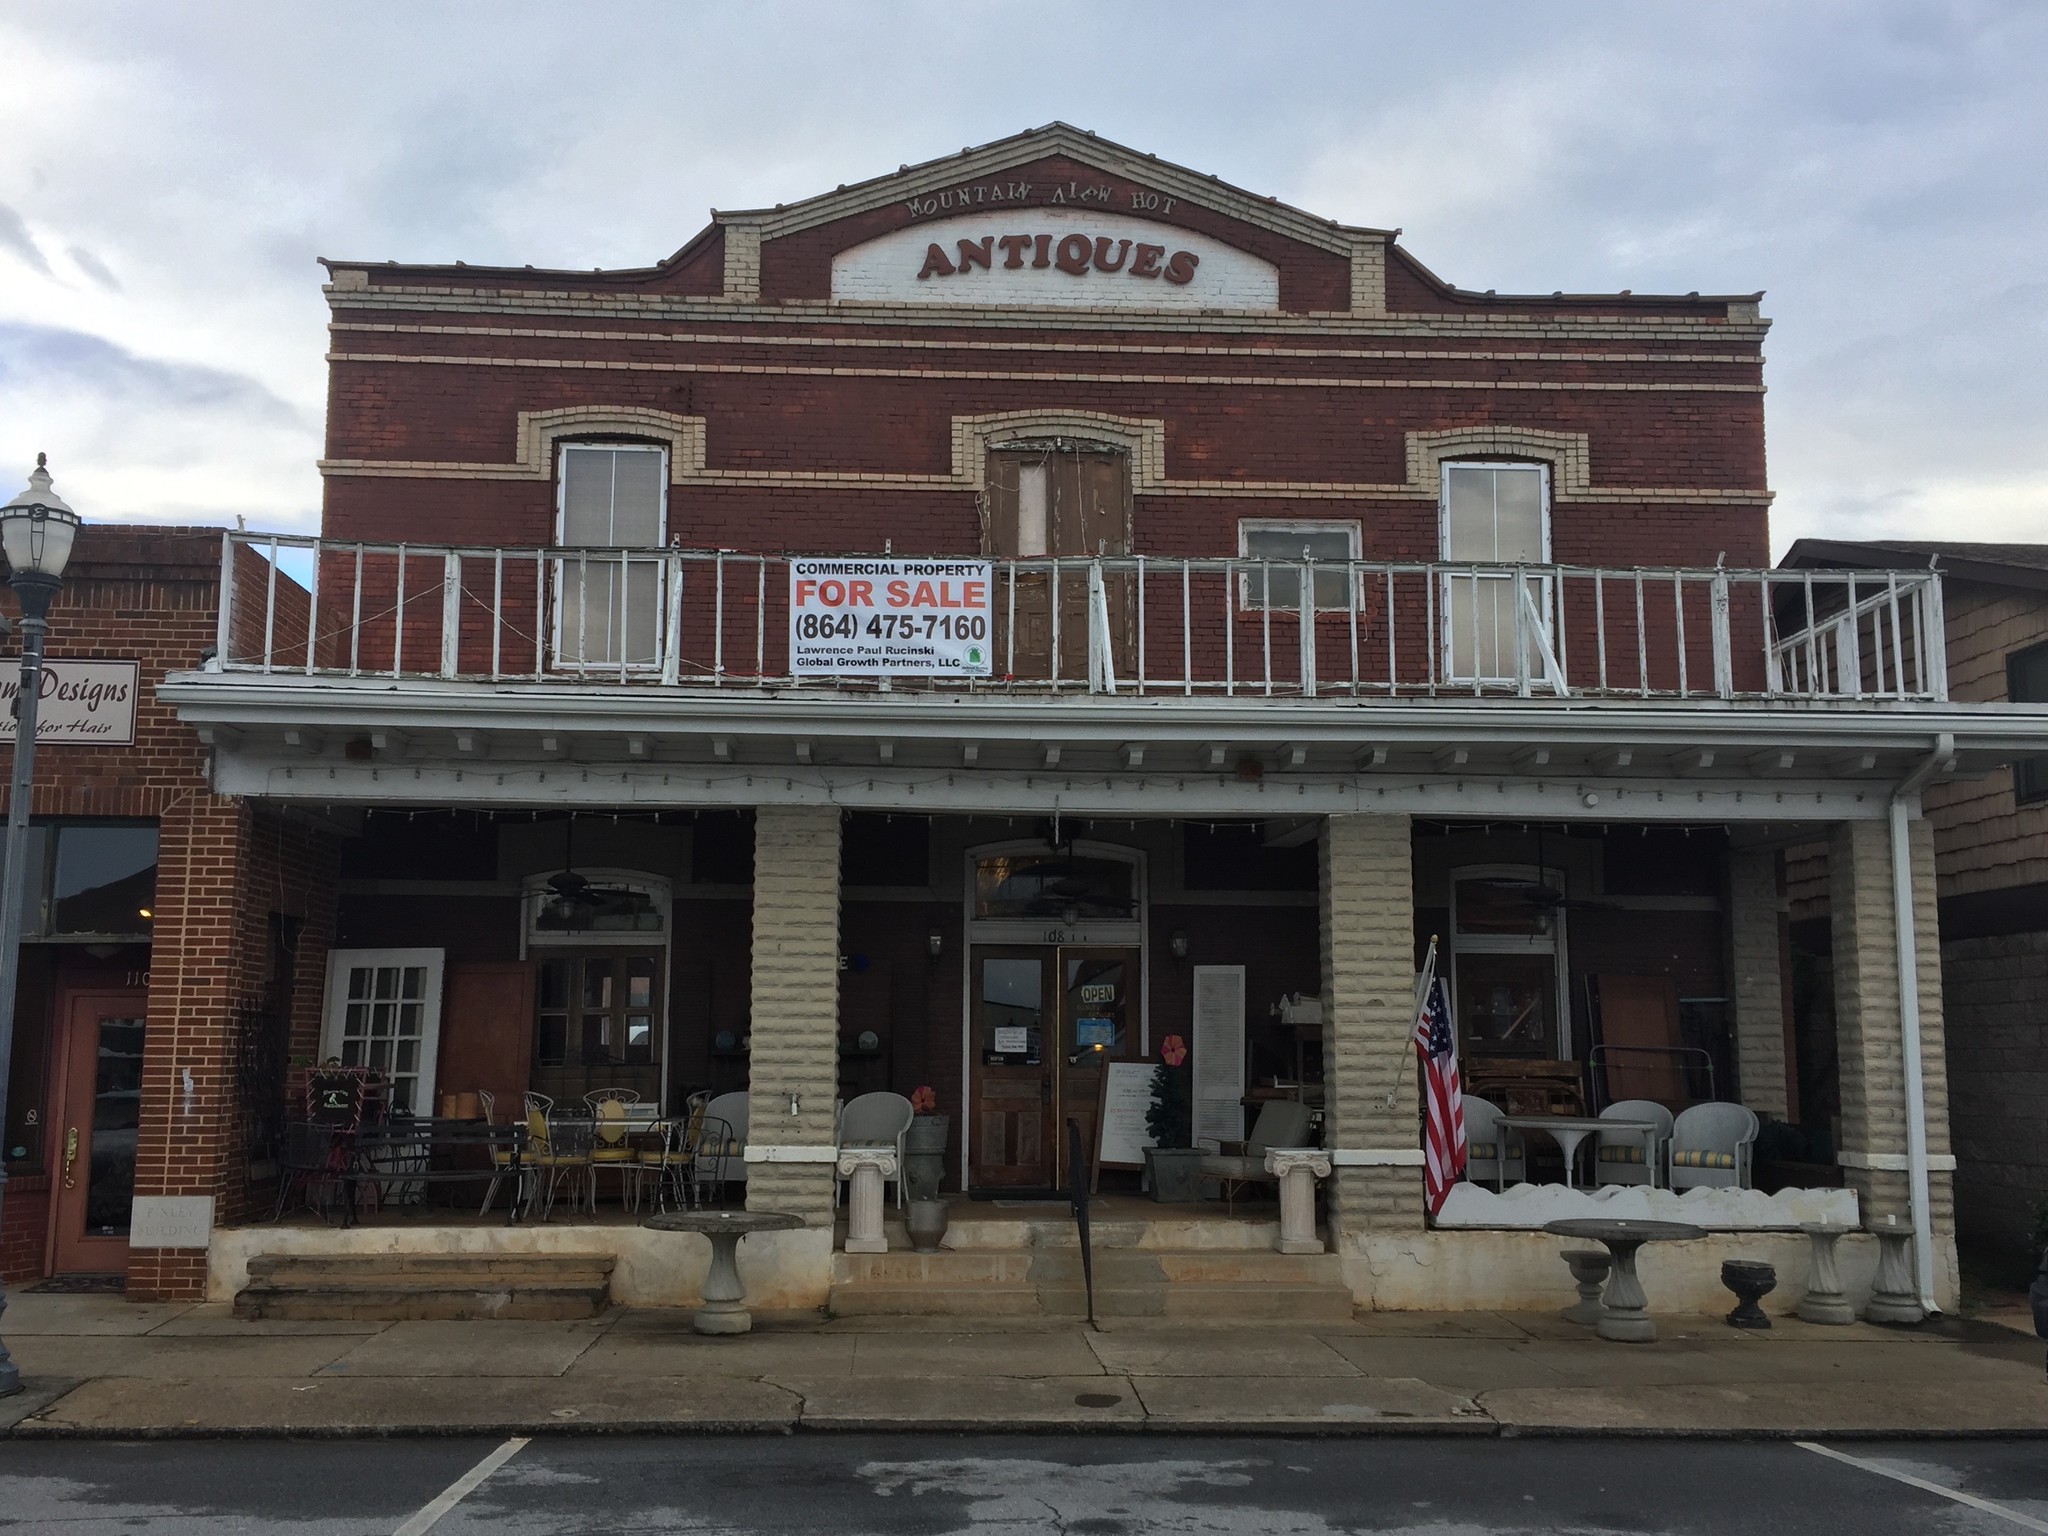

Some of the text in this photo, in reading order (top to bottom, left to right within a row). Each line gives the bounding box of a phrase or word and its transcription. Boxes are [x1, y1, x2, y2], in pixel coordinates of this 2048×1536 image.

[905, 181, 1033, 218] MOUNTAIN
[1130, 191, 1177, 215] HOT
[916, 233, 1200, 285] ANTIQUES
[796, 563, 985, 576] COMMERCIAL PROPERTY
[796, 579, 986, 608] FOR SALE
[795, 613, 986, 640] (864) 475-7160
[797, 645, 935, 655] Lawrence Paul Rucinski
[797, 657, 961, 668] Global Growth Partners, LLC
[39, 667, 128, 712] Designs
[35, 719, 63, 737] for
[66, 719, 112, 734] Hair
[1083, 986, 1113, 1001] OPEN
